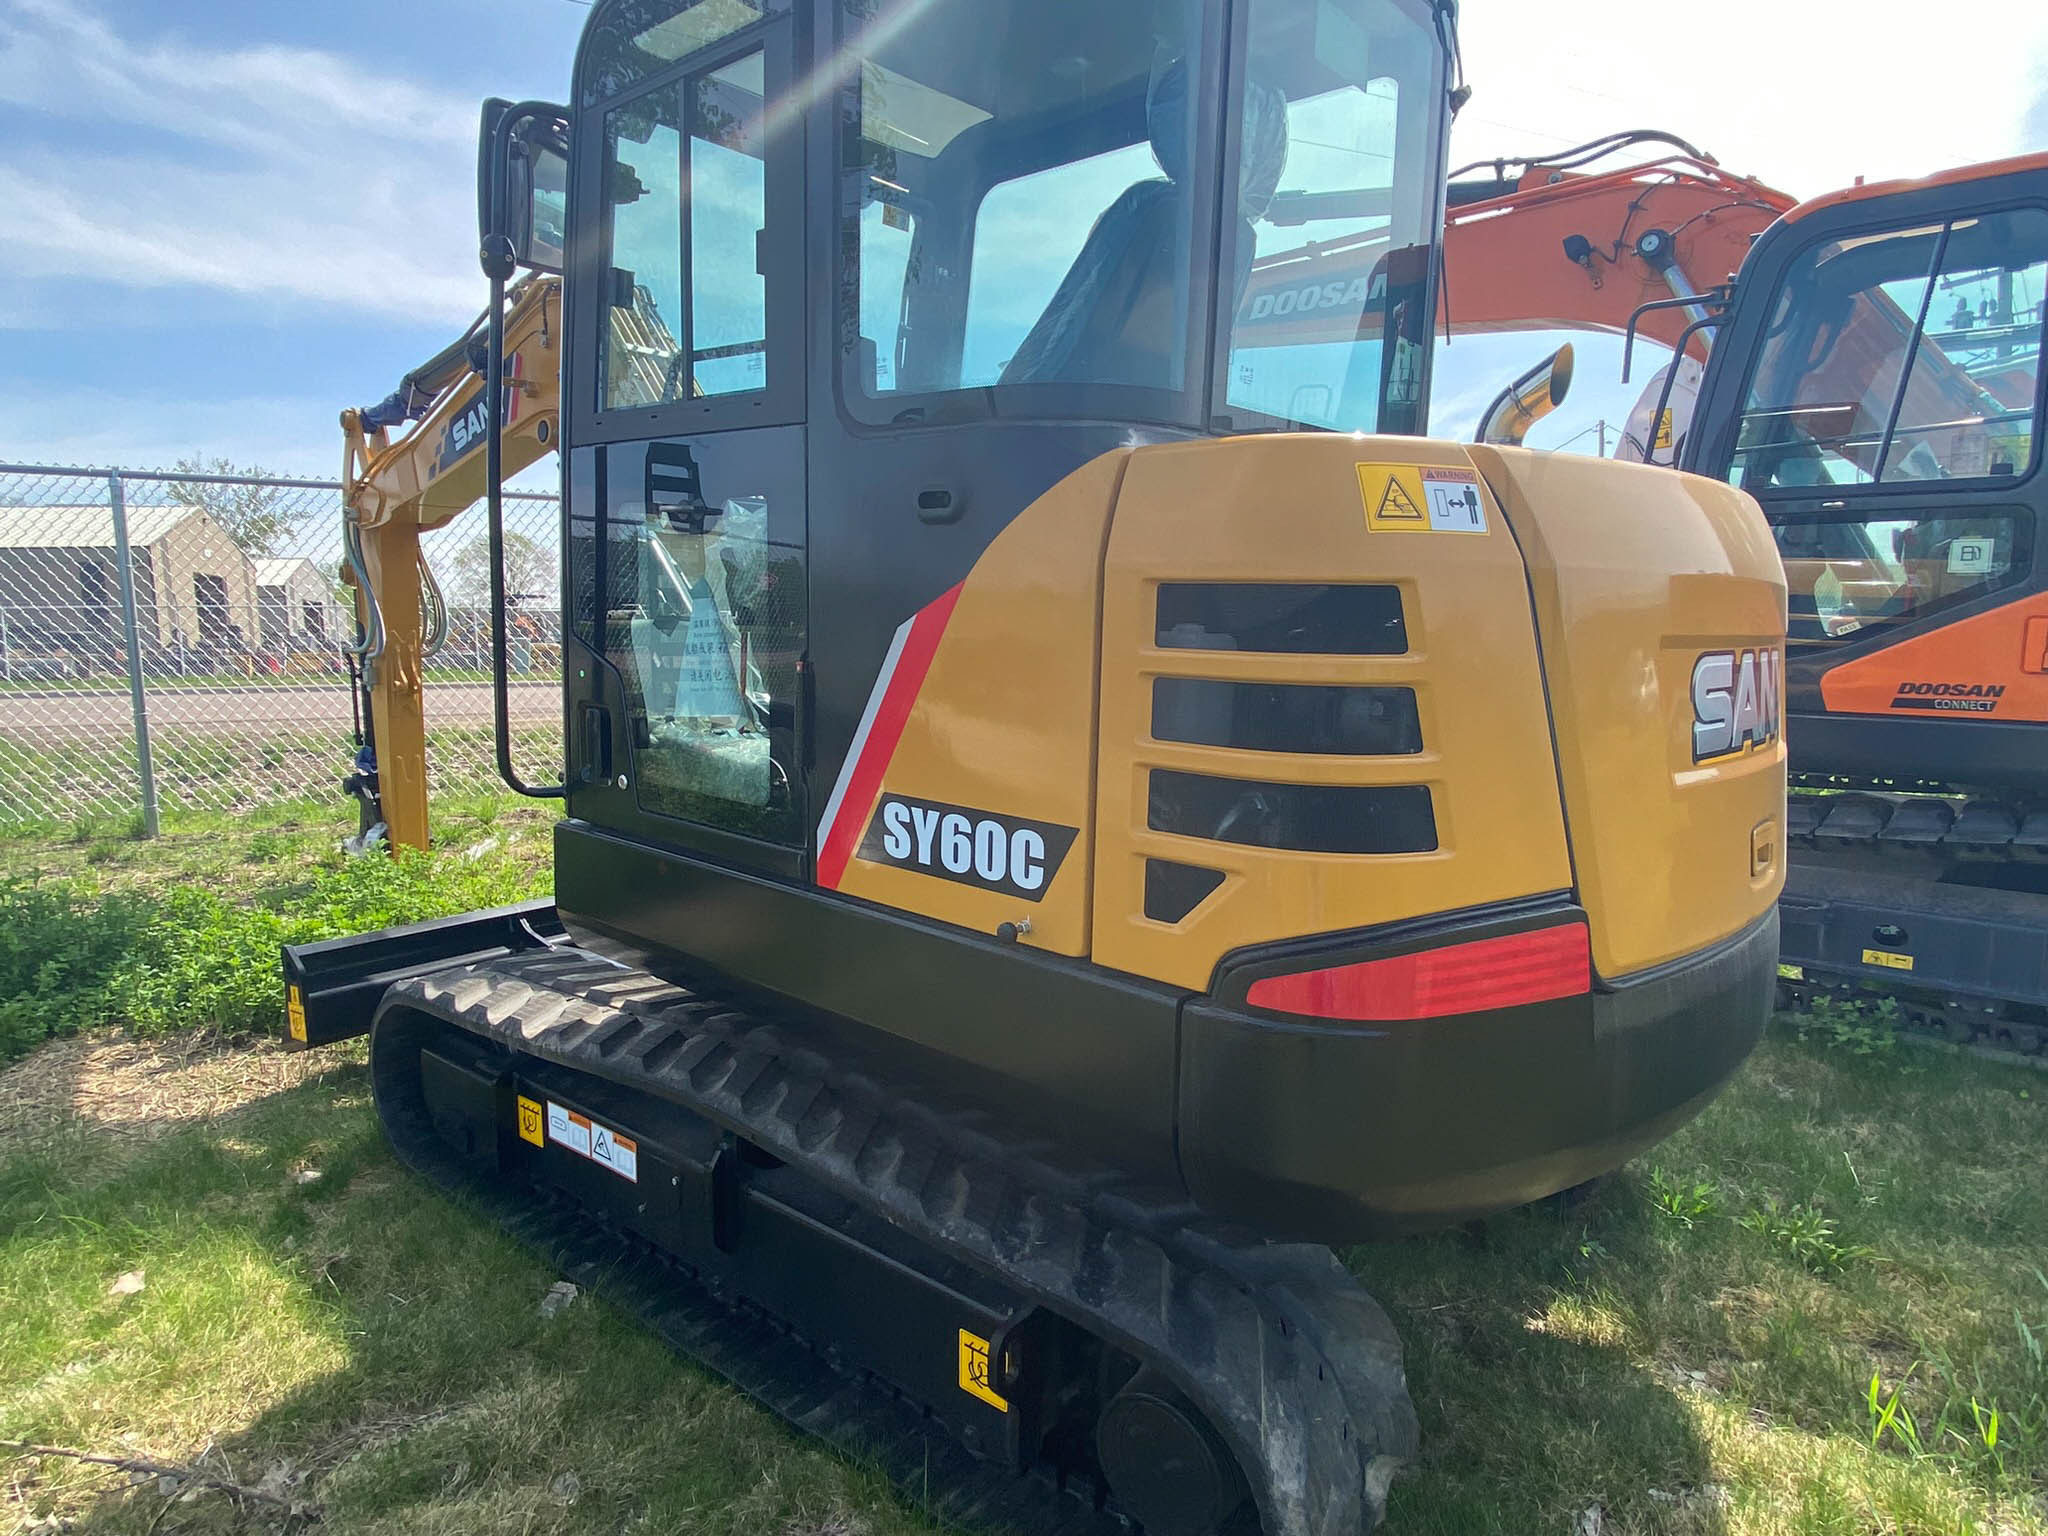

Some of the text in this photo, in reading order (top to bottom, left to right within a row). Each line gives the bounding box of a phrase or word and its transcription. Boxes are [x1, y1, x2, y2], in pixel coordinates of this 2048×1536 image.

[452, 388, 503, 451] SAN
[1435, 470, 1473, 480] WARNING
[1897, 682, 2006, 698] DOOSAN
[1934, 699, 1993, 711] CONNECT
[883, 801, 1045, 890] SY60C
